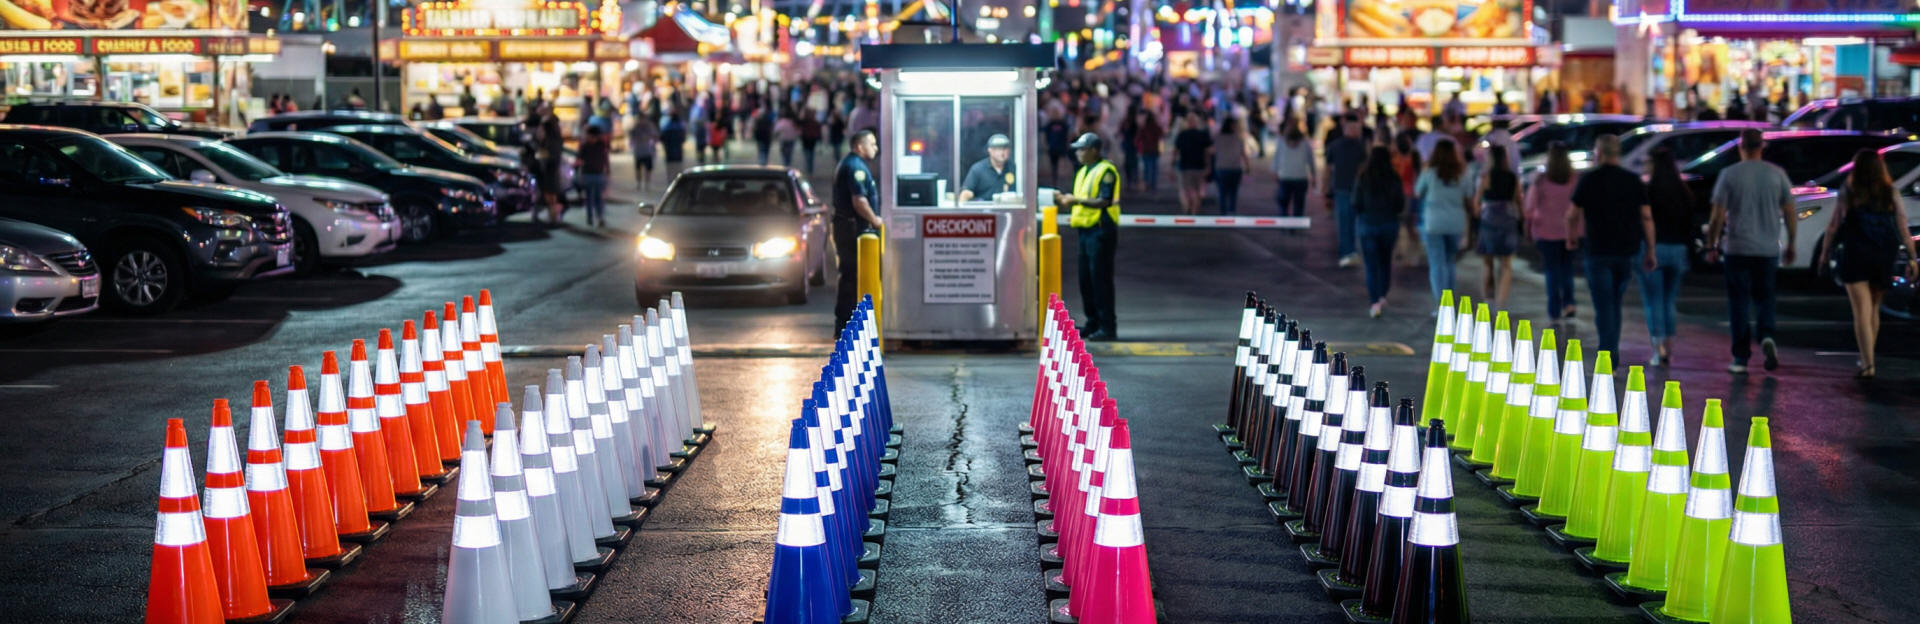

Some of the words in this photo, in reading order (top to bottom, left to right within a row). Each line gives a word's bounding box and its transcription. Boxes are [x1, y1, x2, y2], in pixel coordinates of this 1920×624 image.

[43, 39, 76, 53] FOOD
[161, 39, 195, 53] FOOD
[926, 219, 993, 234] CHECKPOINT
